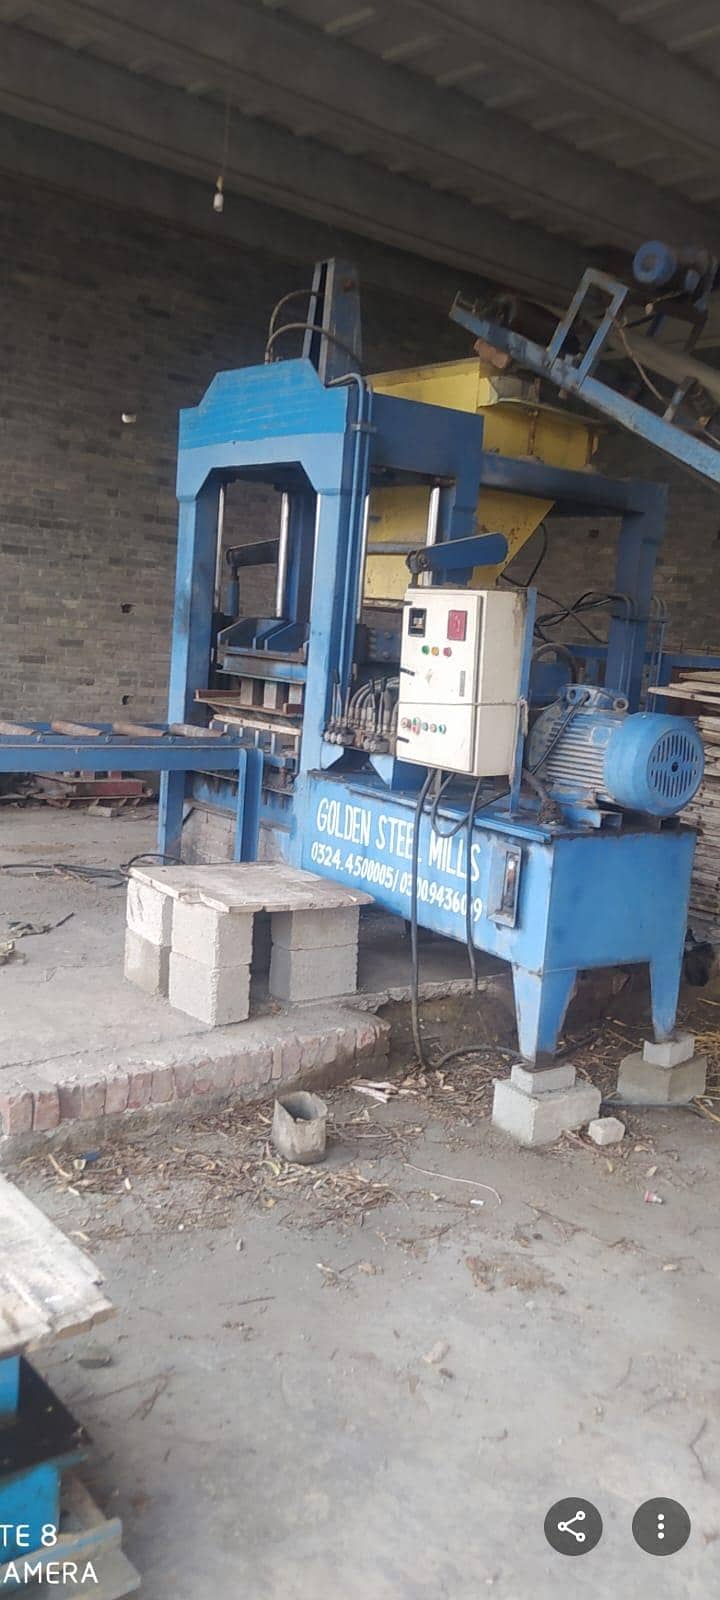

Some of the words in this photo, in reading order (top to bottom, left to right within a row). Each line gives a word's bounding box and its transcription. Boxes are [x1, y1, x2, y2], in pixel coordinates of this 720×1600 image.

[316, 798, 372, 847] GOLDEN
[375, 814, 422, 863] STEE
[428, 829, 481, 882] MILLS
